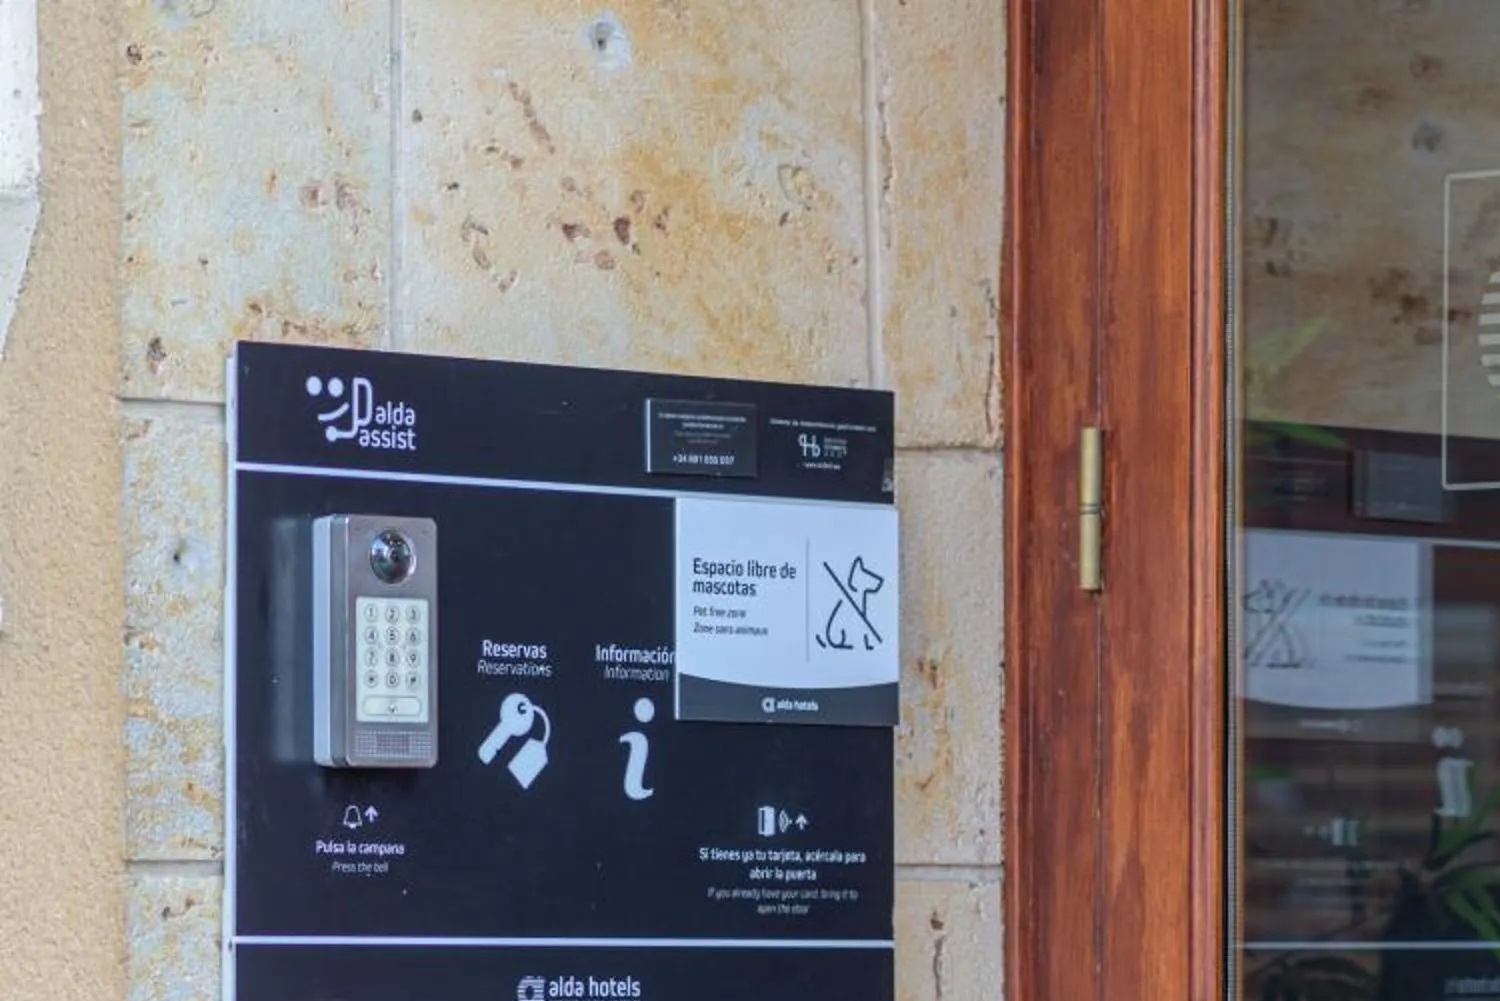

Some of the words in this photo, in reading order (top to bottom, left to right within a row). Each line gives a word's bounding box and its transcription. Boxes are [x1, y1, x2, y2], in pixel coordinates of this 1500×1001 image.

[375, 401, 415, 425] alda
[359, 425, 416, 450] assist
[693, 557, 744, 578] Espacio
[747, 560, 777, 578] libre
[779, 562, 797, 579] de
[692, 580, 756, 596] mascotas
[483, 640, 547, 659] Reservas
[477, 659, 552, 677] Reservations
[604, 665, 670, 681] Information
[315, 840, 344, 854] Pulsa
[347, 840, 356, 854] la
[358, 843, 405, 856] campana
[710, 848, 740, 861] tienes
[741, 850, 754, 863] ya
[755, 849, 766, 861] tu
[845, 852, 866, 864] para
[332, 861, 356, 872] Press
[749, 866, 774, 880] abrir
[775, 867, 784, 880] la
[785, 869, 817, 884] puerta
[549, 976, 584, 997] alda
[589, 976, 641, 997] hotels
